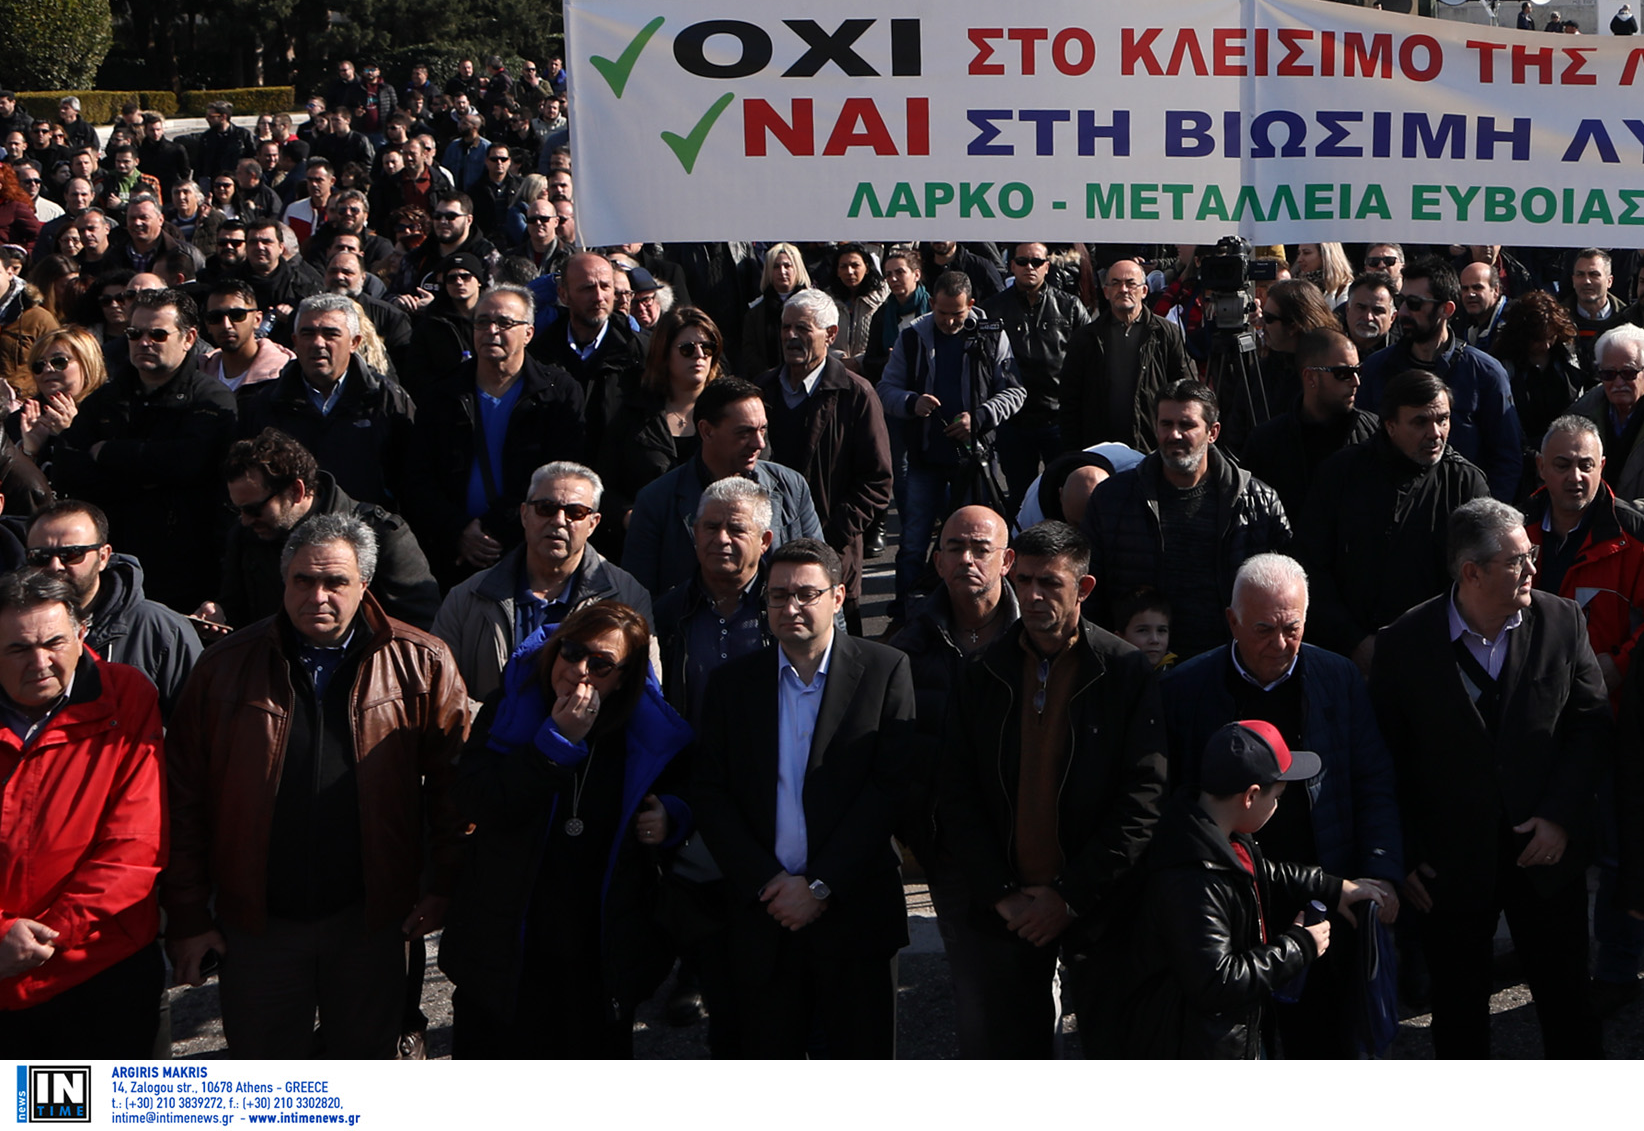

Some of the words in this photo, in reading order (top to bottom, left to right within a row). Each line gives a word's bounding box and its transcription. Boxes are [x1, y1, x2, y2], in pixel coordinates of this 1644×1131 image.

[672, 18, 922, 79] ΟΧΙ
[966, 27, 1097, 77] ΣΤΟ
[1120, 27, 1444, 82] ΚΛΕΙΣΙΜΟ
[1465, 38, 1599, 86] ΤΗΣ
[742, 96, 931, 157] ΝΑΙ
[965, 108, 1132, 158] ΣΤΗ
[1164, 108, 1533, 162] ΒΙΩΣΙΜΗ
[846, 181, 1035, 220] ΛΑΡΚΟ
[1085, 182, 1393, 223] ΜΕΤΑΛΛΕΙΑ
